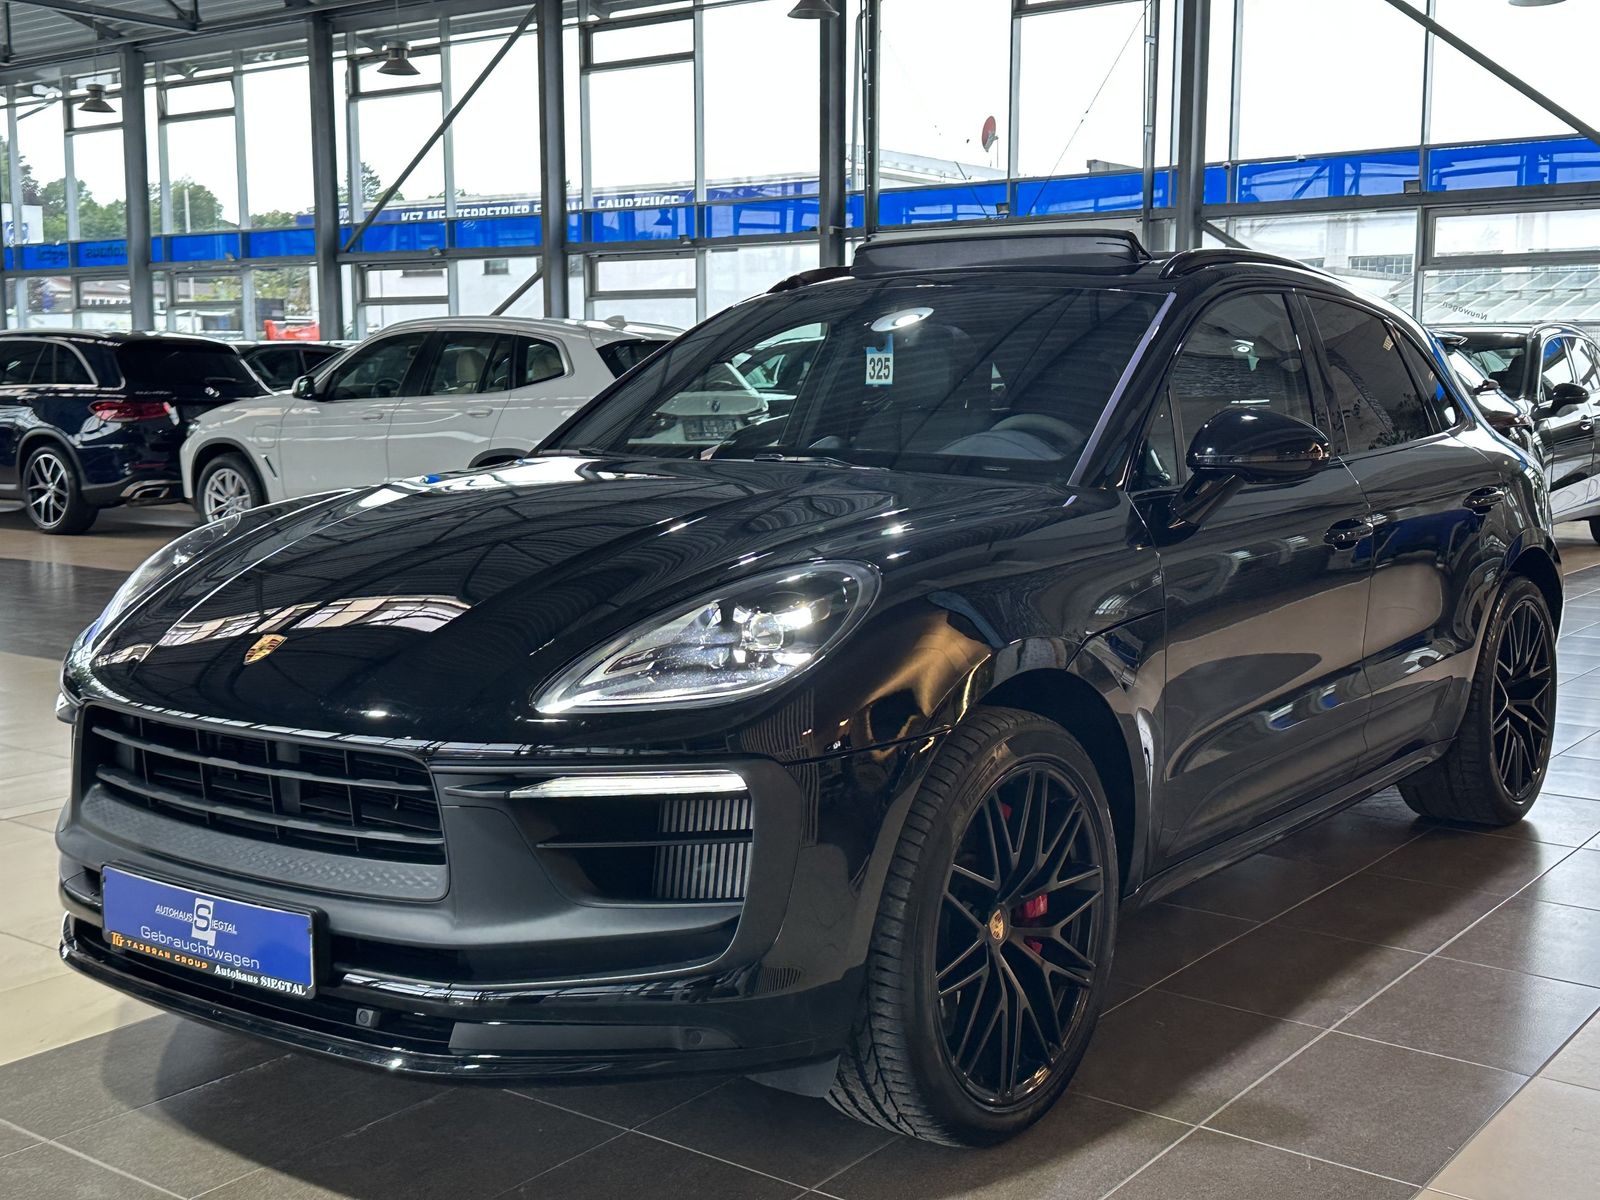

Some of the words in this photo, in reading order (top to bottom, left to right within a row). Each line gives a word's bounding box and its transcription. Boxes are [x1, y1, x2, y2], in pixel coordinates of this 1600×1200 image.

[868, 357, 890, 380] 325
[155, 904, 193, 923] AUTOHAUS
[140, 925, 260, 969] Gebrauchtwagen
[174, 954, 208, 969] GROUP
[214, 965, 258, 984] Autohaus
[260, 975, 306, 996] SIEGTAL
